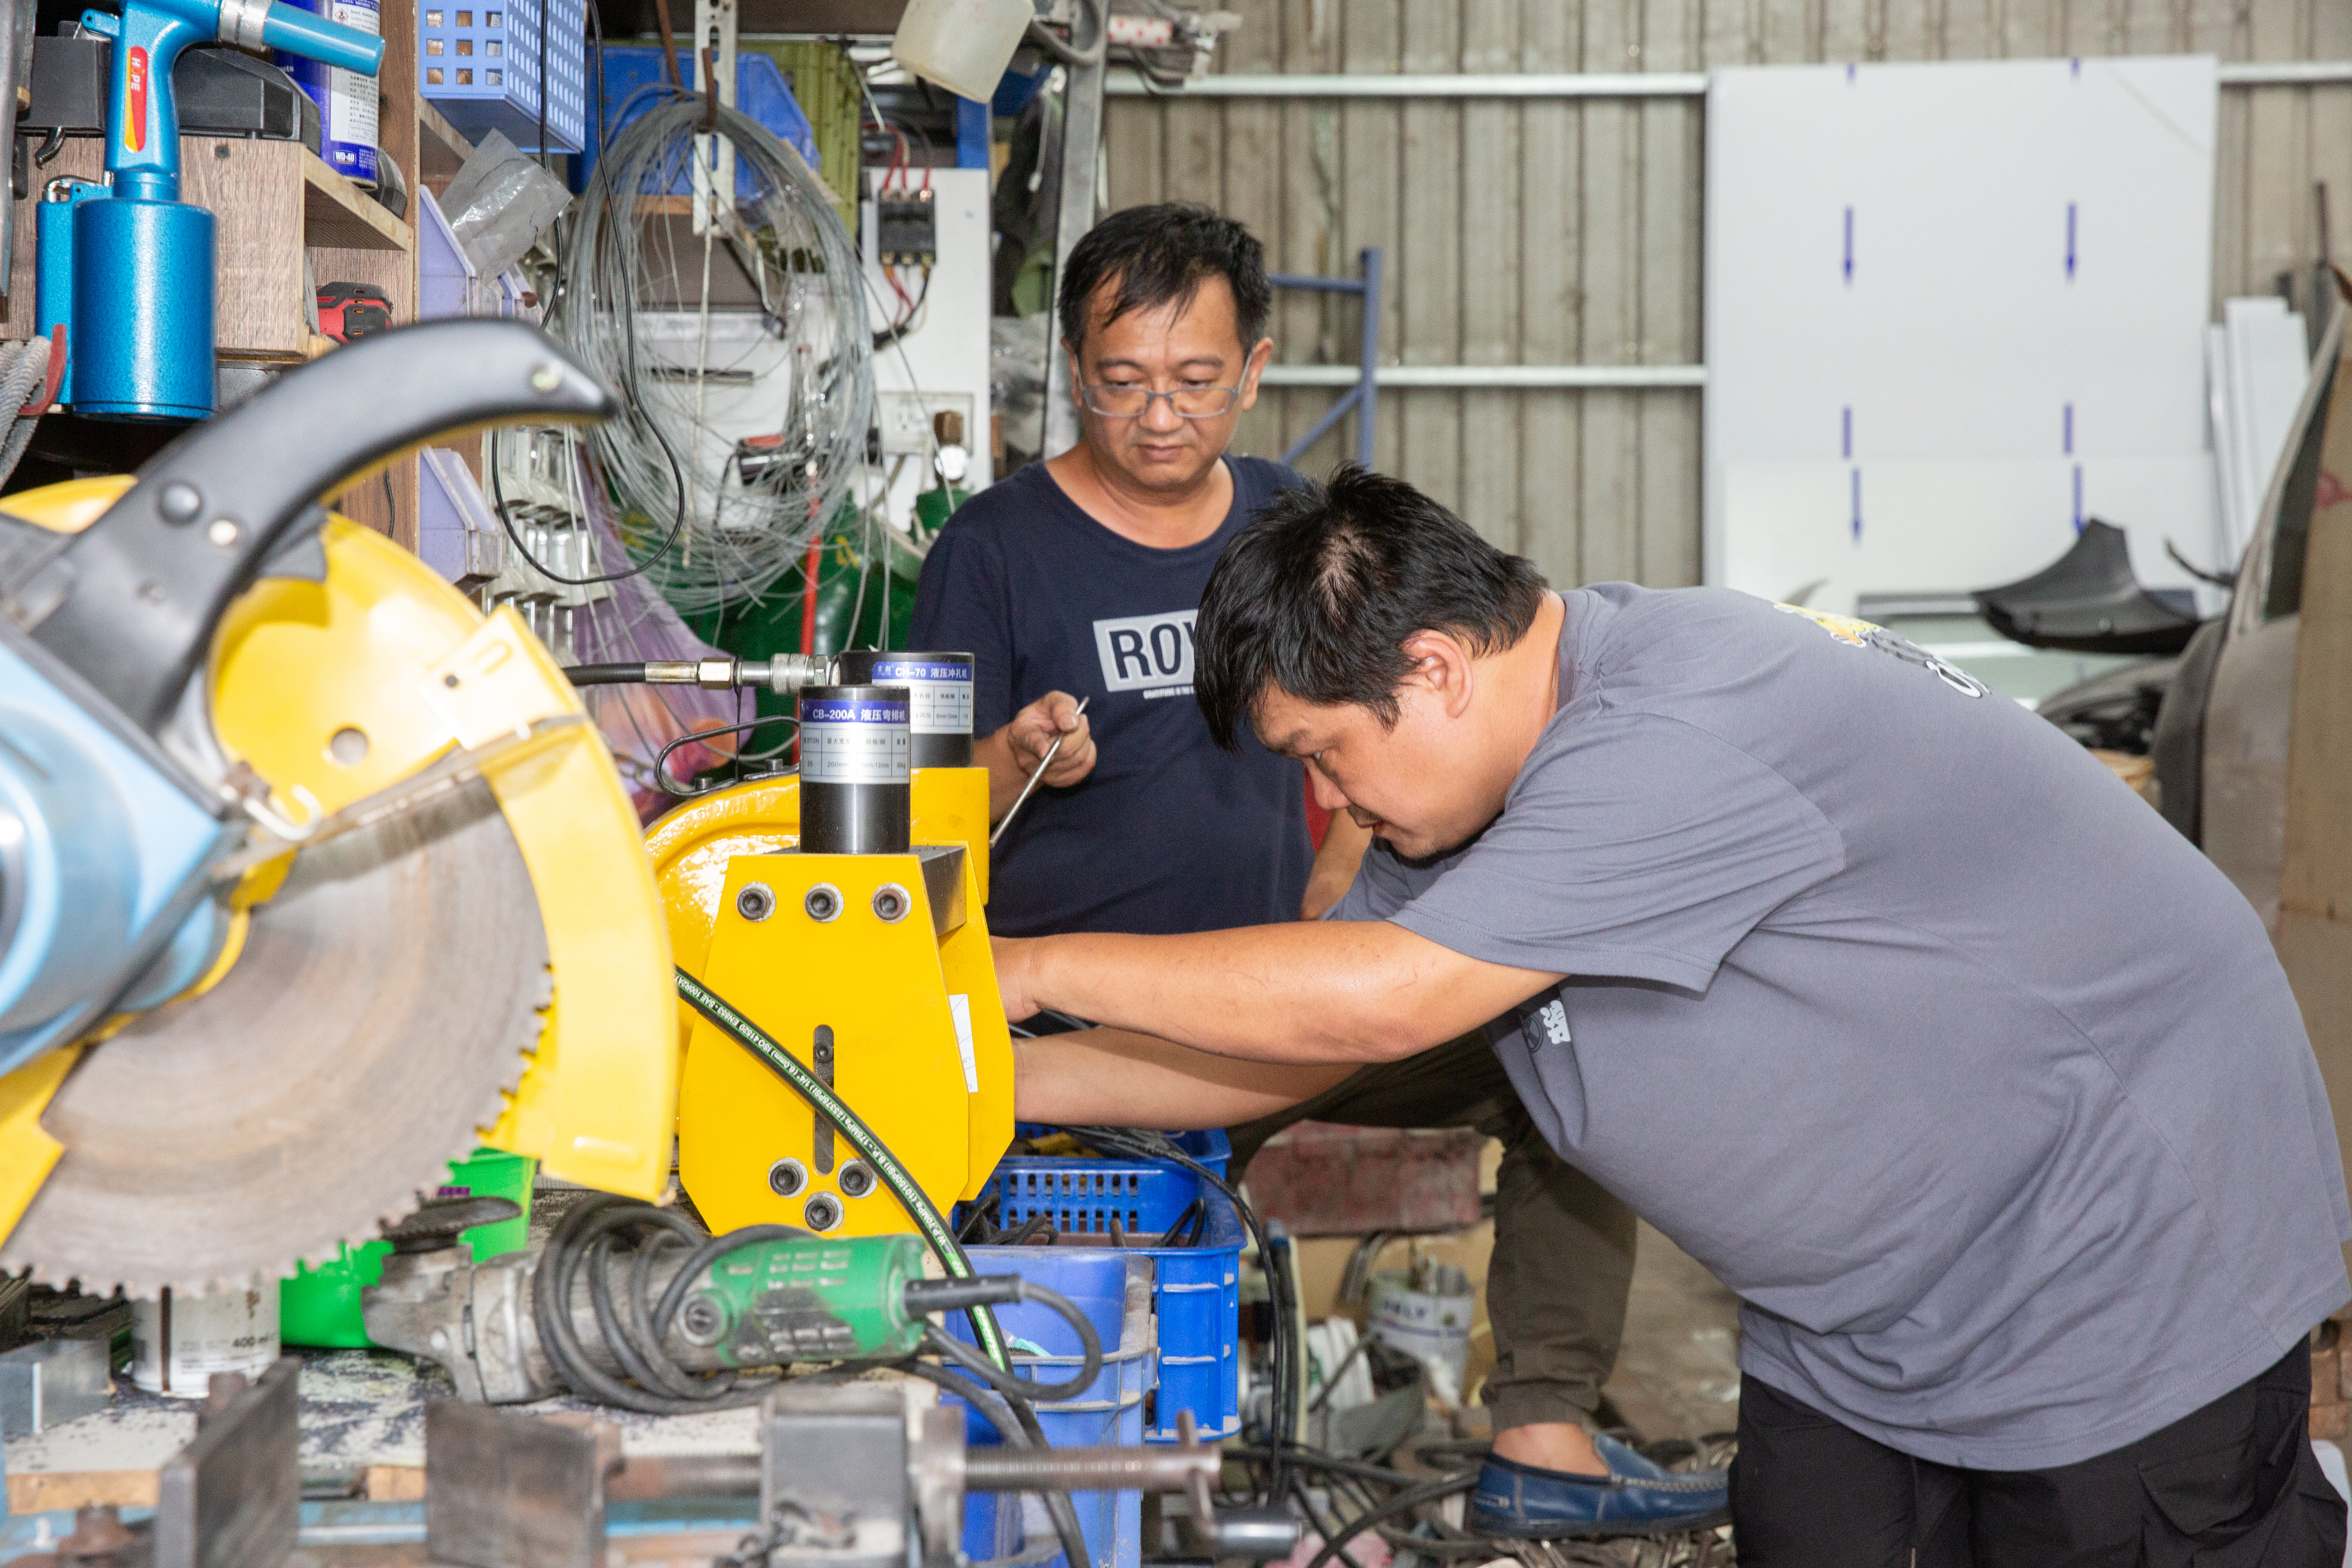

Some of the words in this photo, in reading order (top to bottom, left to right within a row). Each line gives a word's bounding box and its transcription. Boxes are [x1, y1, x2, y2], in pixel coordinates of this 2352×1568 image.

[131, 57, 141, 91] HOPE
[895, 667, 926, 677] CH-70
[931, 668, 967, 679] 液压冲孔机
[813, 709, 856, 720] CB-200A
[861, 709, 905, 721] 液压弯排机
[700, 994, 716, 1008] SAE
[739, 1024, 760, 1042] 41520
[758, 1040, 773, 1053] ISO
[771, 1050, 799, 1076] (6.0mm)
[809, 1085, 846, 1121] (25375PSI)
[845, 1118, 869, 1145] 175MPa
[884, 1162, 917, 1202] (10150PSI)
